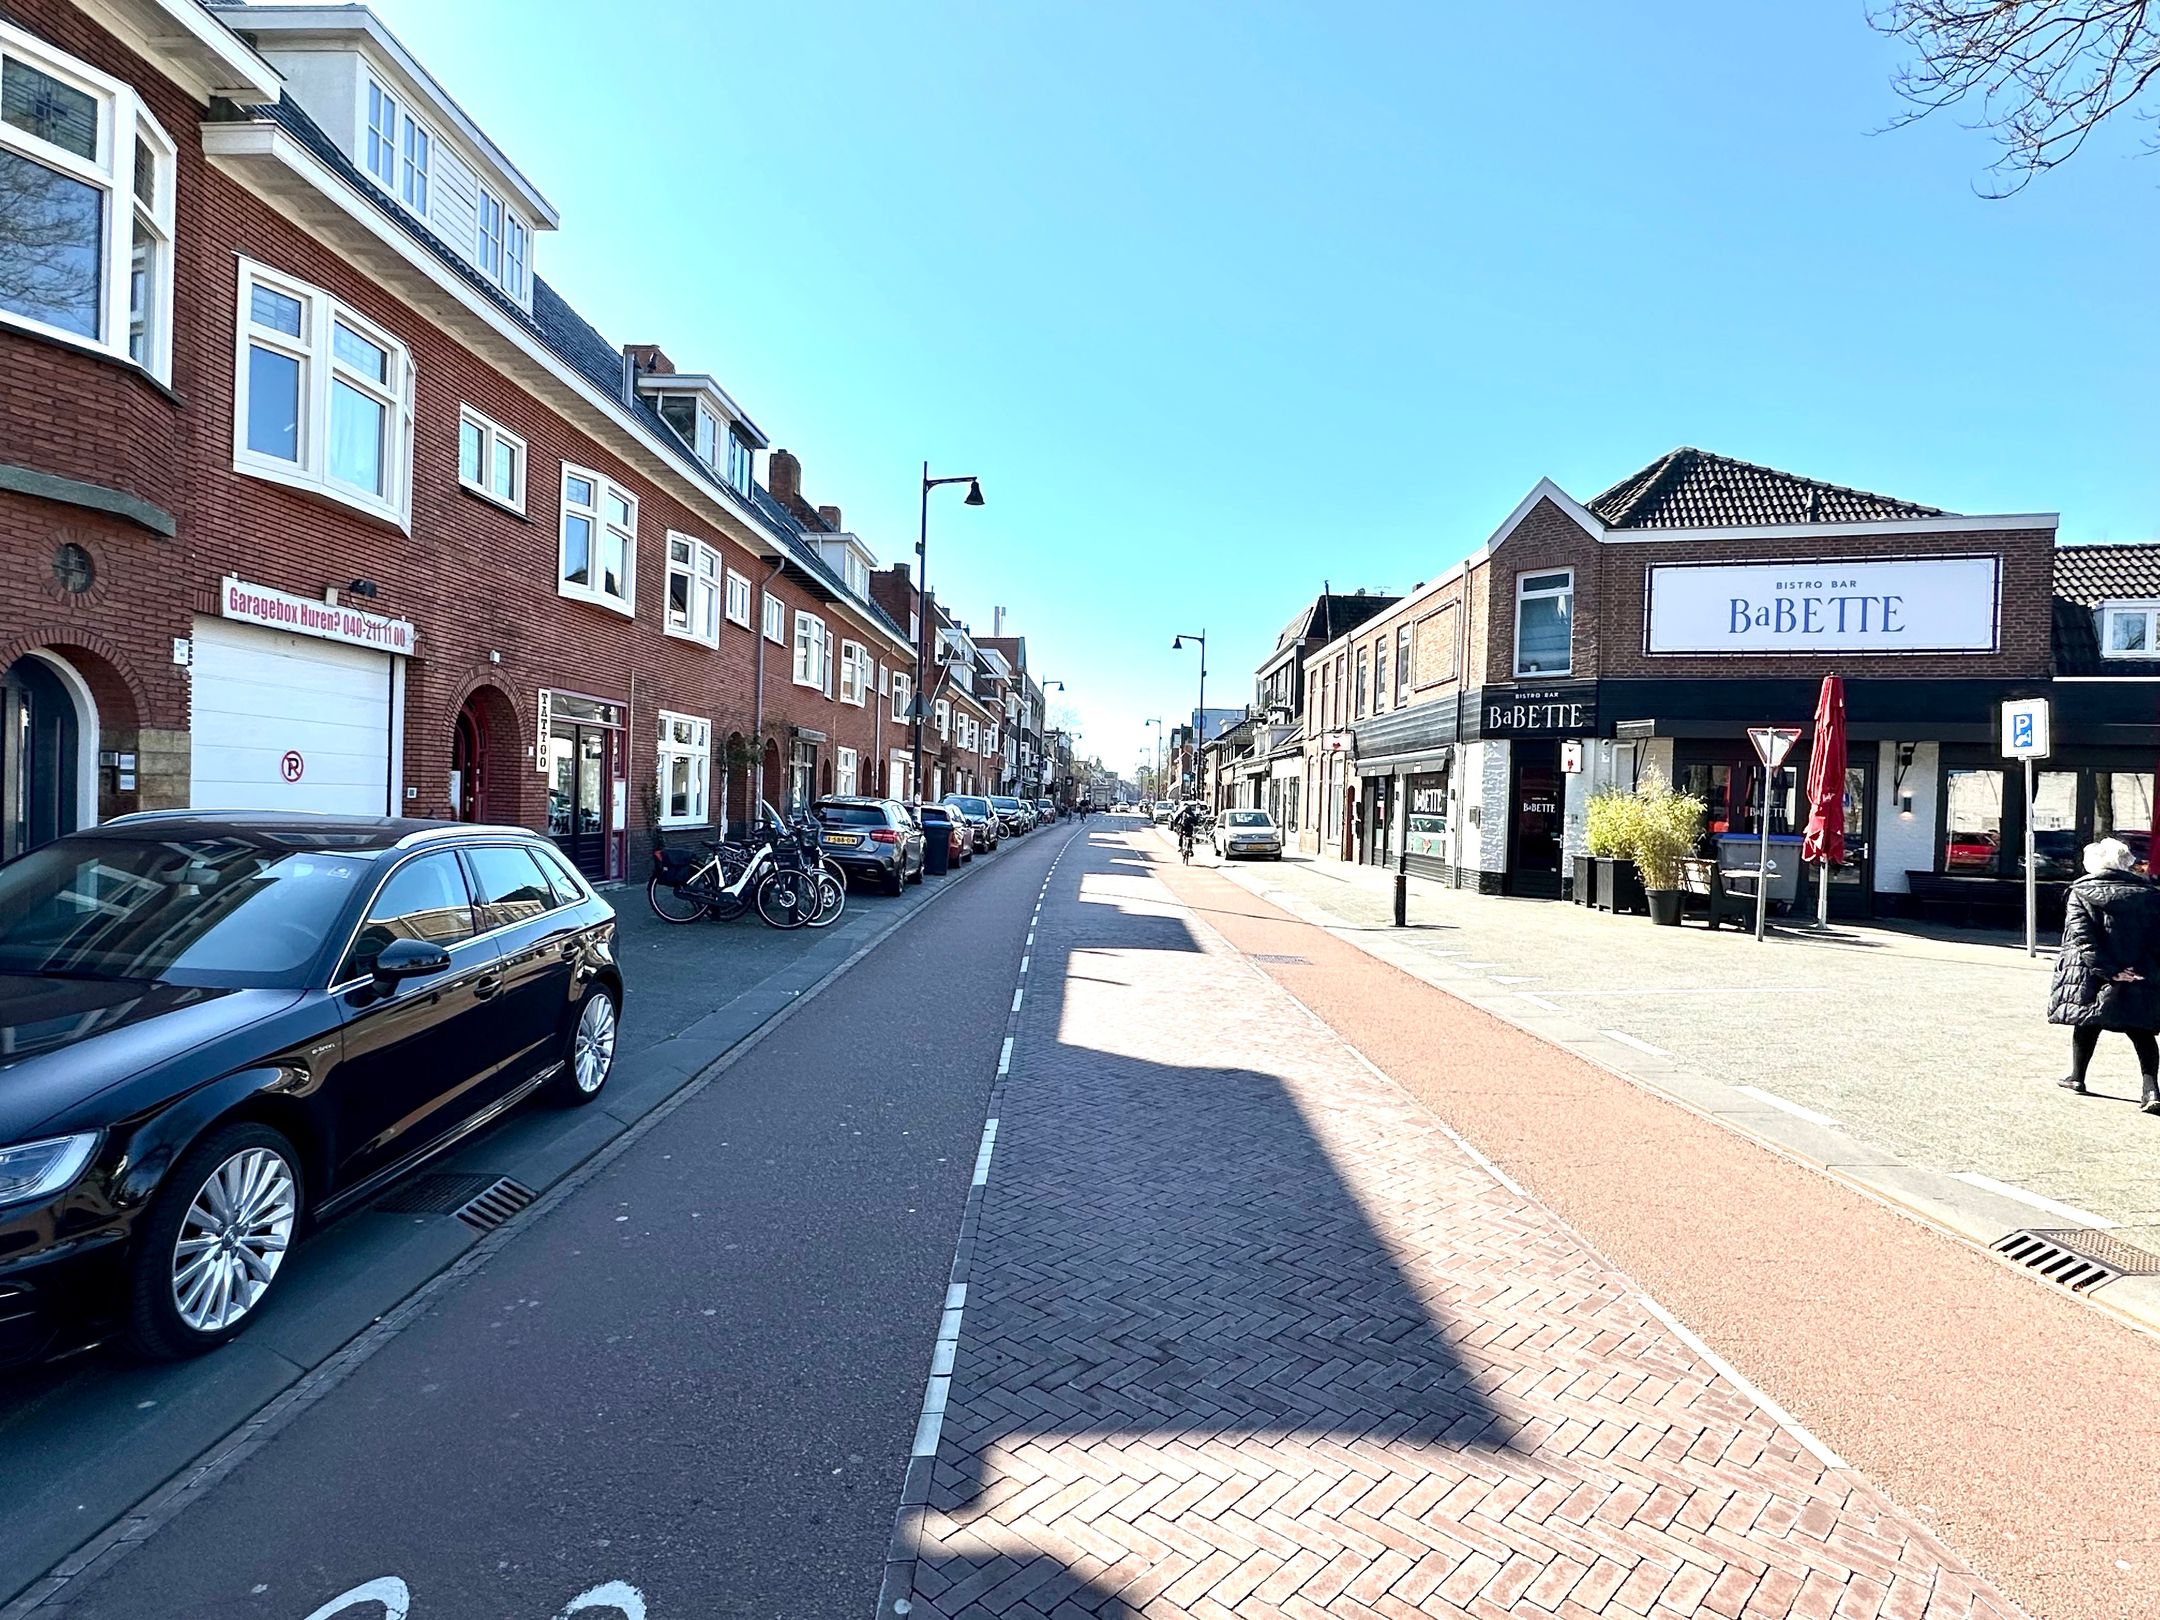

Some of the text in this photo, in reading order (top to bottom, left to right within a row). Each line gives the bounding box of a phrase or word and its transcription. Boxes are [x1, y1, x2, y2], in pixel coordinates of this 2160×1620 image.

[1776, 580, 1857, 590] BISTRO BAR
[229, 586, 298, 625] Garagebox
[301, 603, 340, 632] Huren?
[1728, 596, 1906, 634] BaBETTE
[540, 693, 549, 768] TATTOO
[1489, 703, 1584, 729] BaBETTE
